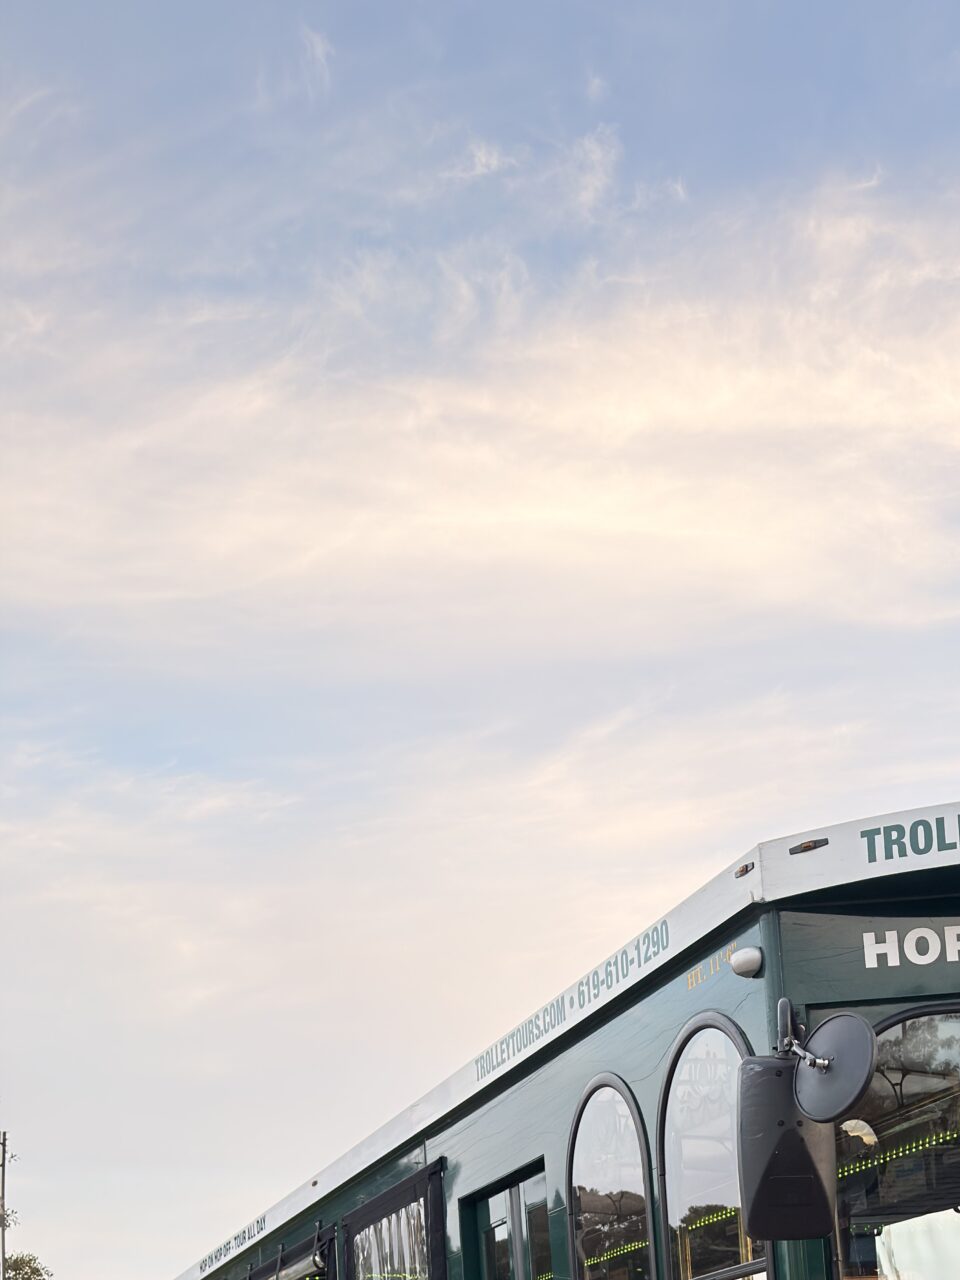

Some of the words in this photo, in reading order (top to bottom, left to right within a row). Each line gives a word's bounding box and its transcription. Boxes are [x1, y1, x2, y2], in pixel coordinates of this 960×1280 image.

[474, 997, 567, 1082] TROLLEYTOURS.COM
[577, 919, 670, 1010] 619-610-1290
[257, 1214, 267, 1235] DAY
